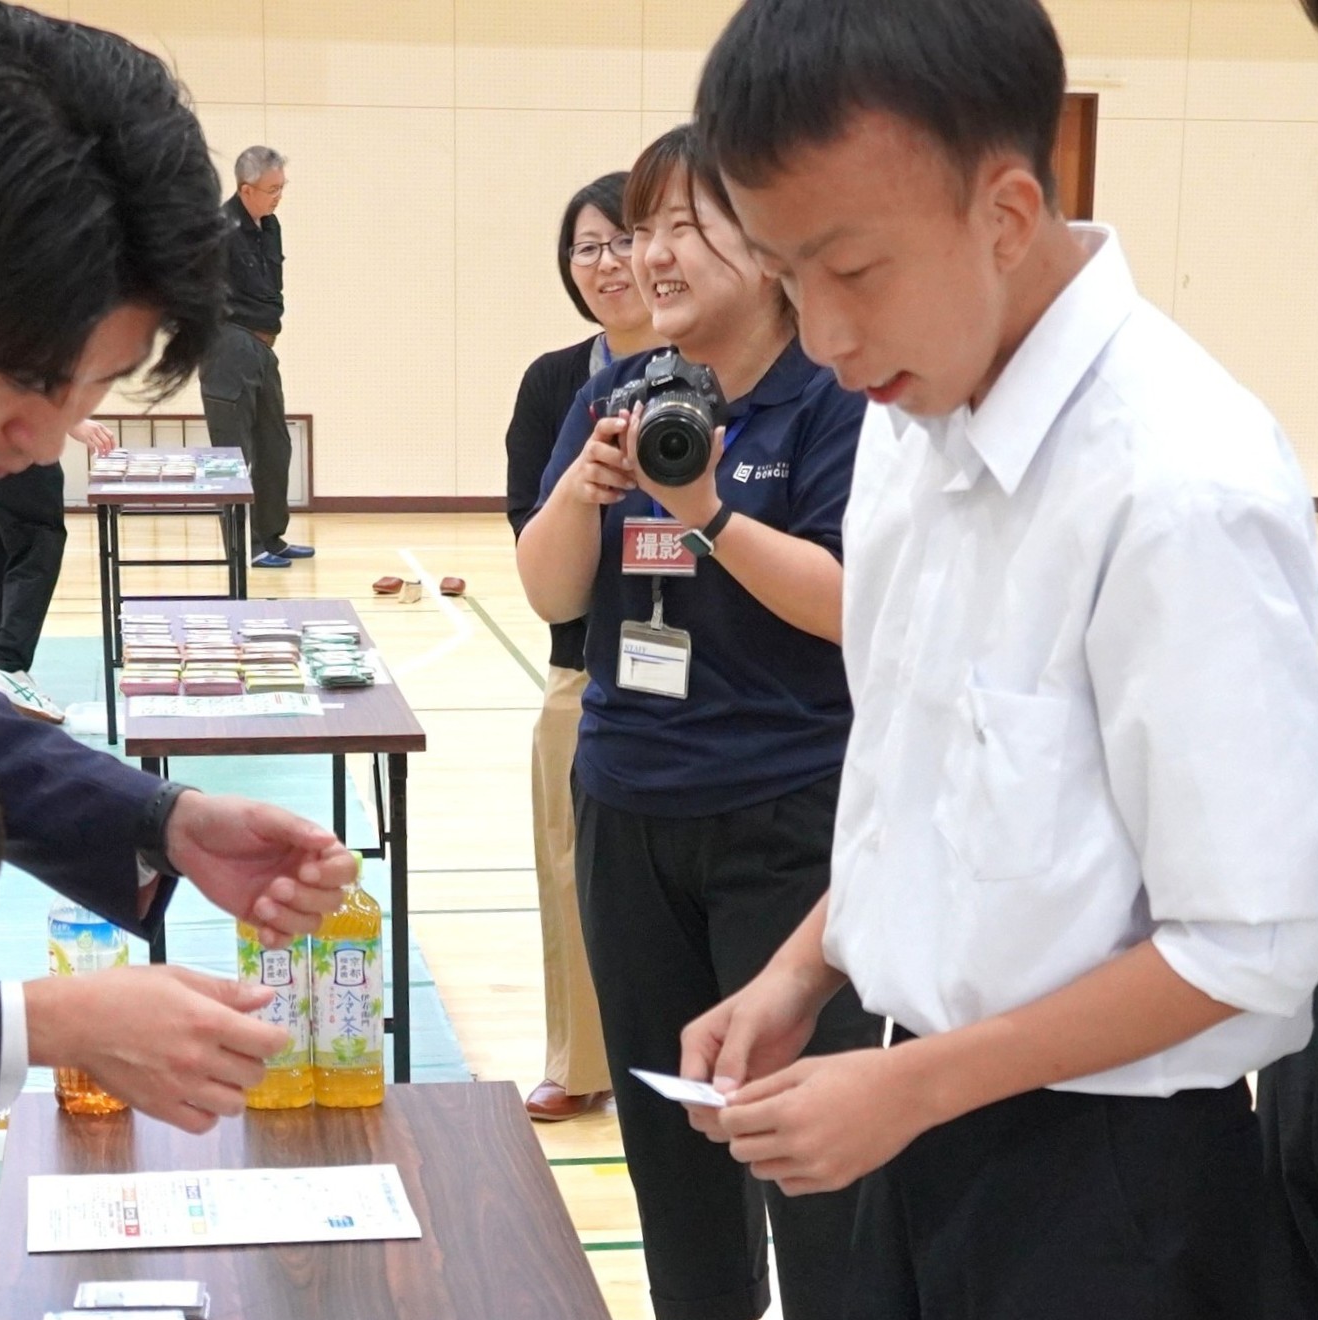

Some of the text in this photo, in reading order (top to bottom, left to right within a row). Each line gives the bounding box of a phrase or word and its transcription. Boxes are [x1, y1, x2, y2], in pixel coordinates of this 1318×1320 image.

[651, 375, 674, 387] Canon
[635, 531, 683, 561] 撮影
[349, 956, 362, 979] 京都
[335, 989, 363, 1041] 冷茶
